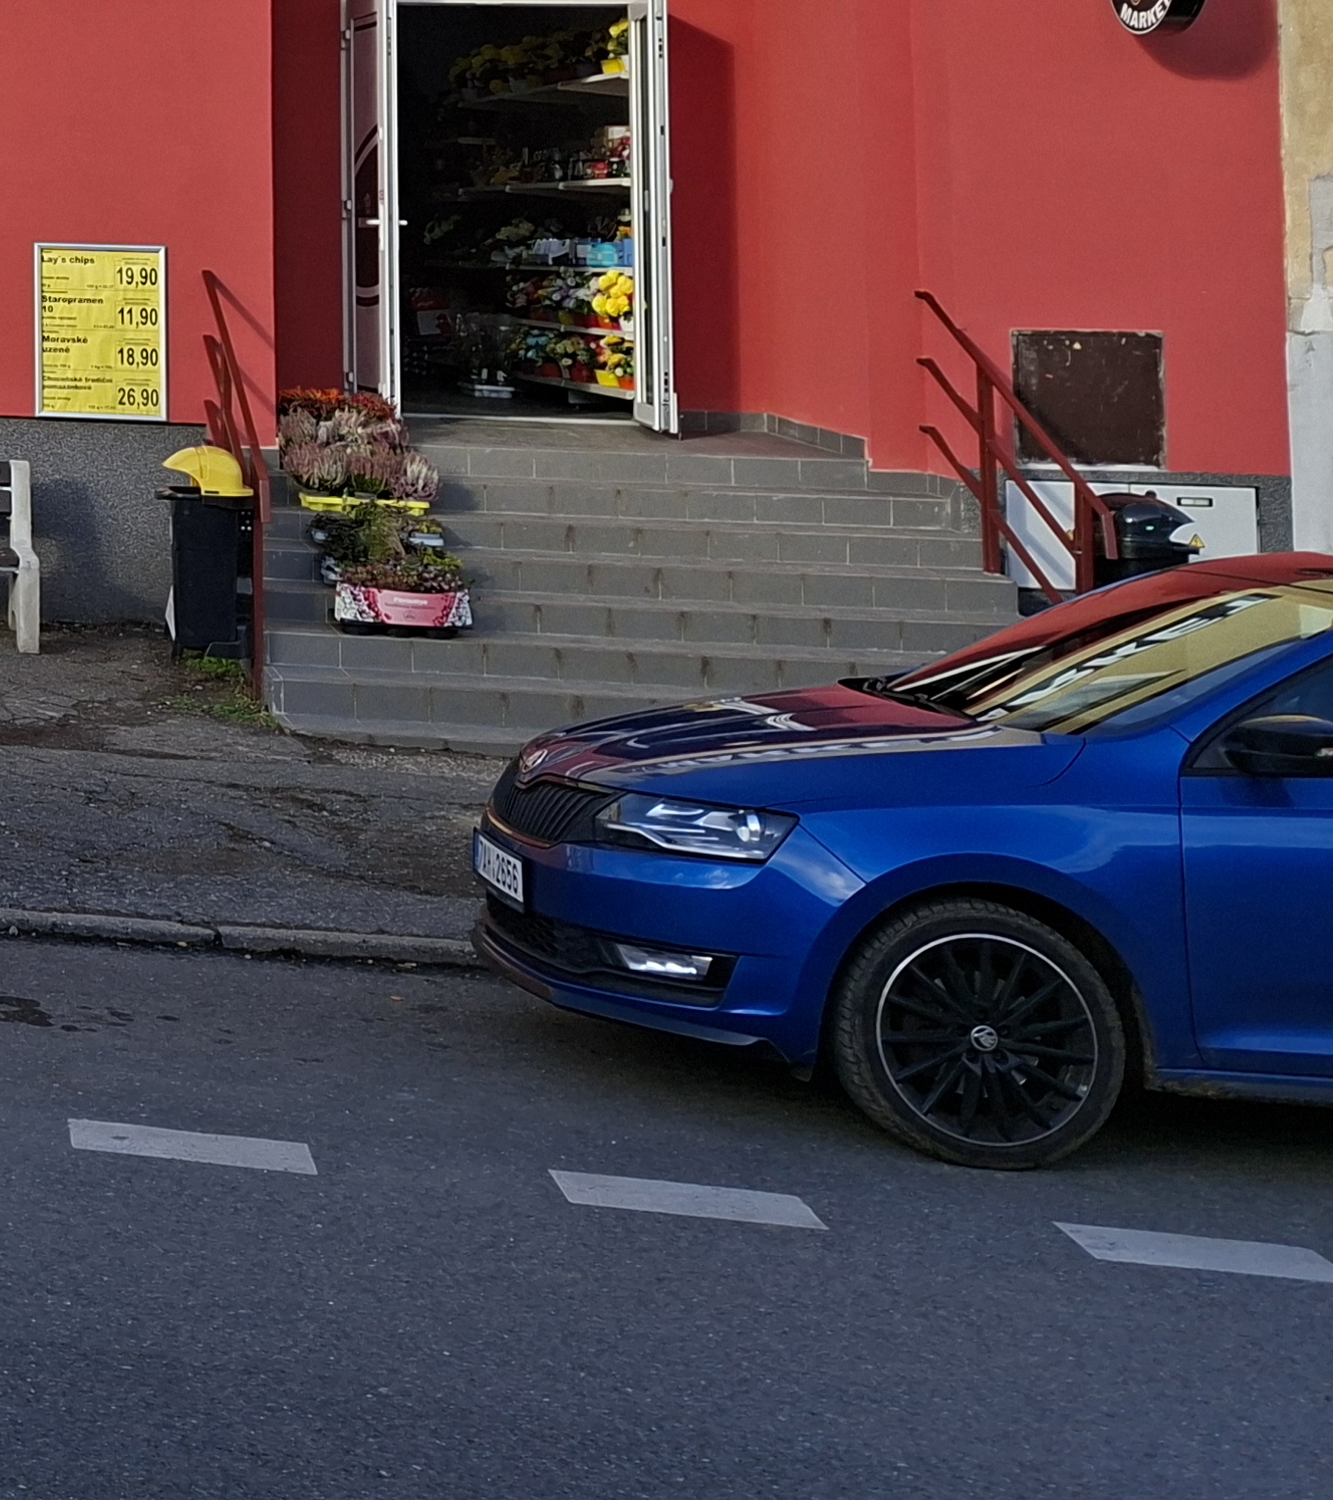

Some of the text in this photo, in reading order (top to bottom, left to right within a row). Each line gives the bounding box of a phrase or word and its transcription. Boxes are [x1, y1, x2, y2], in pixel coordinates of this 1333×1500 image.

[69, 256, 95, 265] chips
[116, 266, 158, 288] 19,90
[42, 295, 104, 304] Staropramen
[117, 307, 158, 329] 11,90
[42, 334, 88, 344] Moravské
[117, 347, 159, 369] 18,90
[118, 387, 159, 410] 26,90
